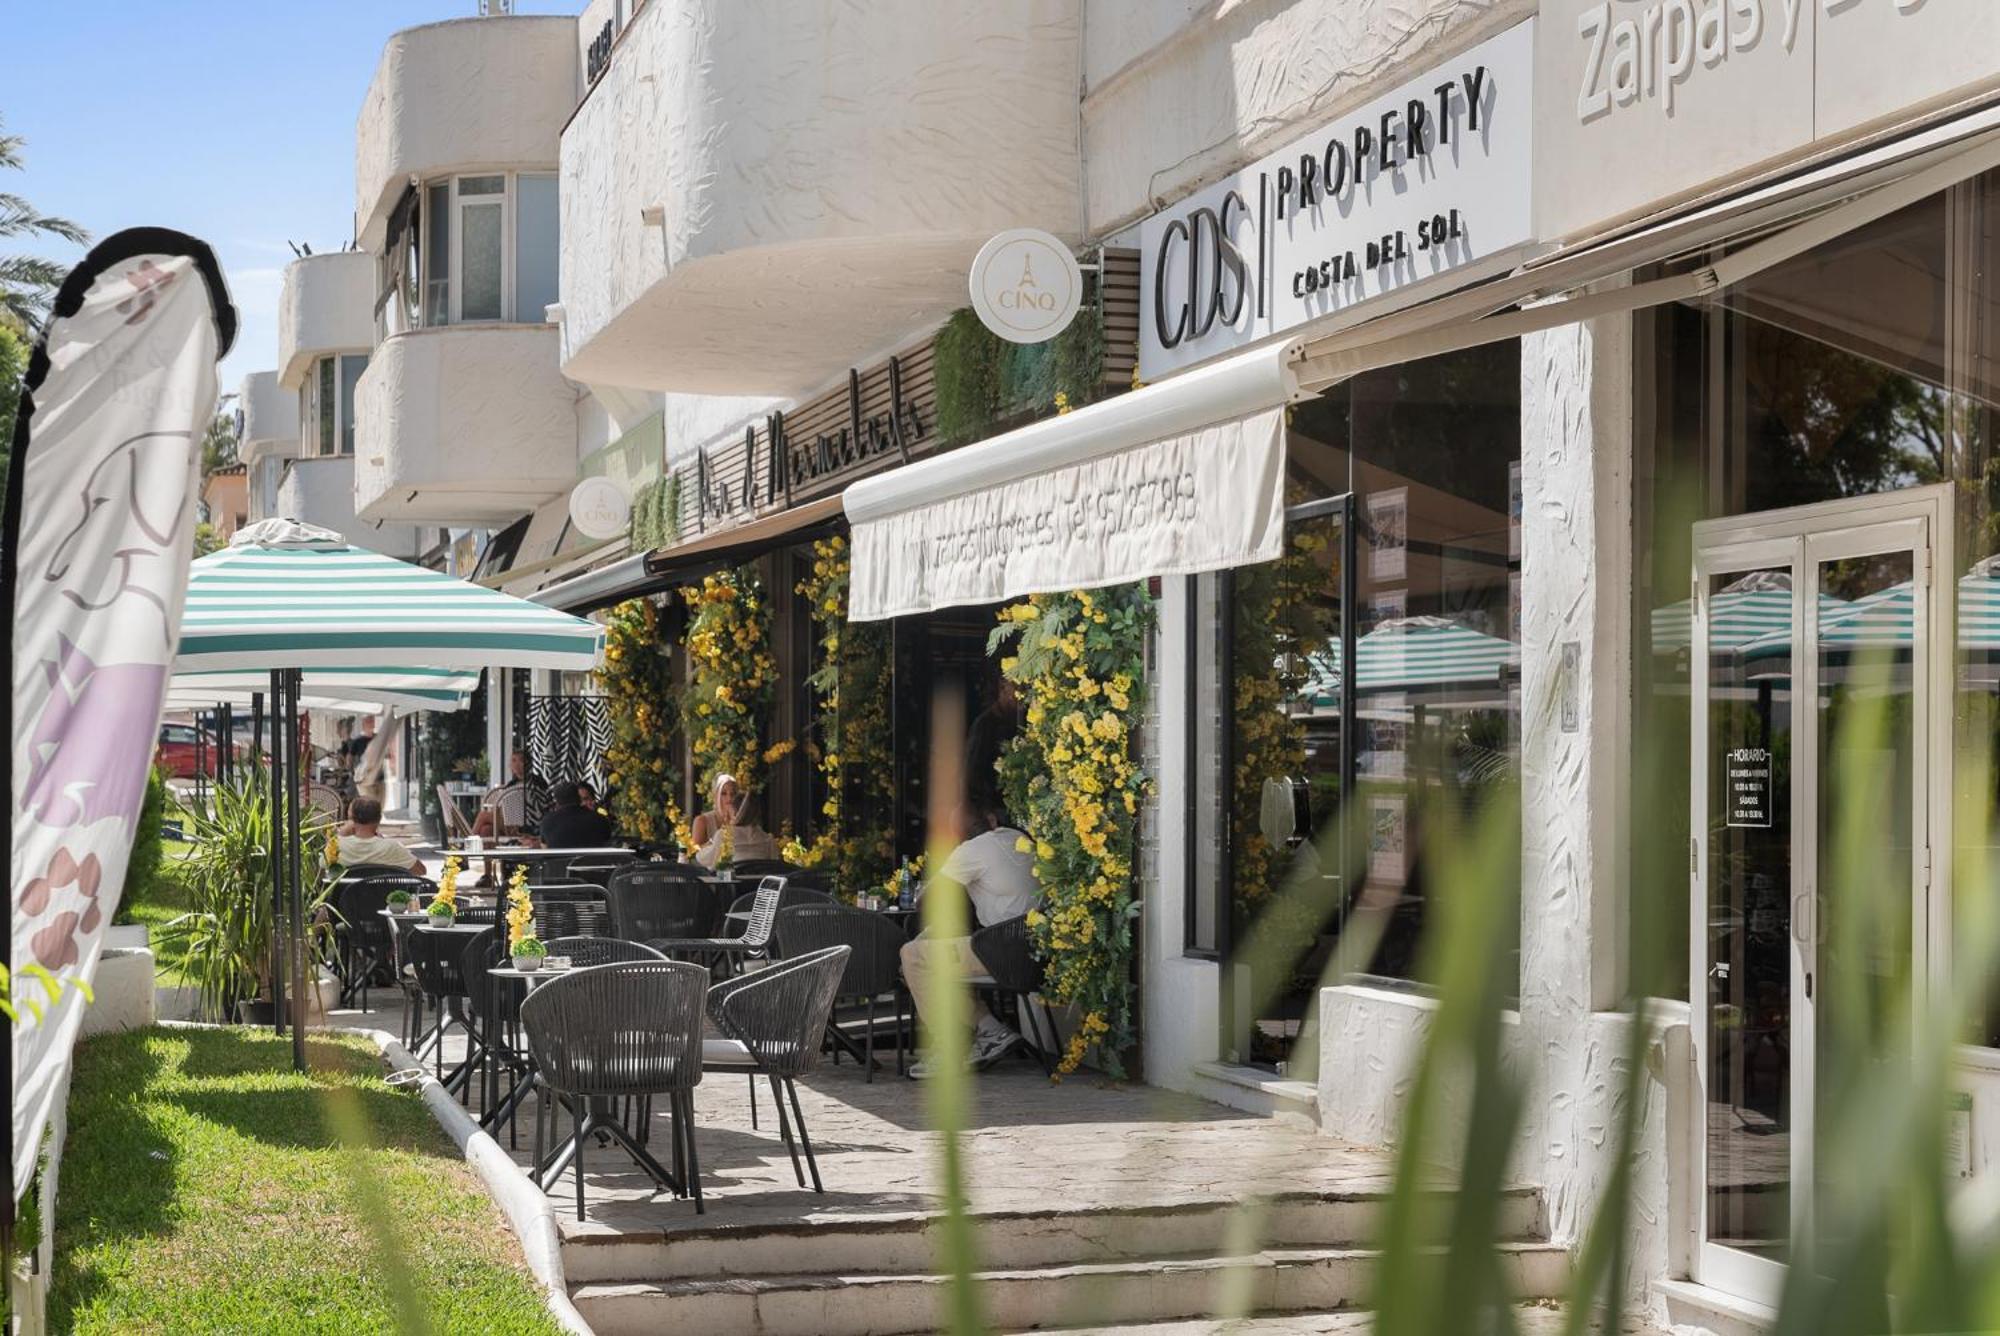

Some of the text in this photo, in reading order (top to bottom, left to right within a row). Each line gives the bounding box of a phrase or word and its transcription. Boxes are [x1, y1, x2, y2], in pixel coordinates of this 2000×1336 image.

[1578, 0, 1762, 120] Zarpas
[1277, 65, 1485, 220] PROPERTY
[999, 290, 1056, 311] CINQ
[1155, 190, 1245, 350] CDS
[1293, 209, 1462, 299] COSTA DEL SOL
[1733, 748, 1766, 762] HORARIO
